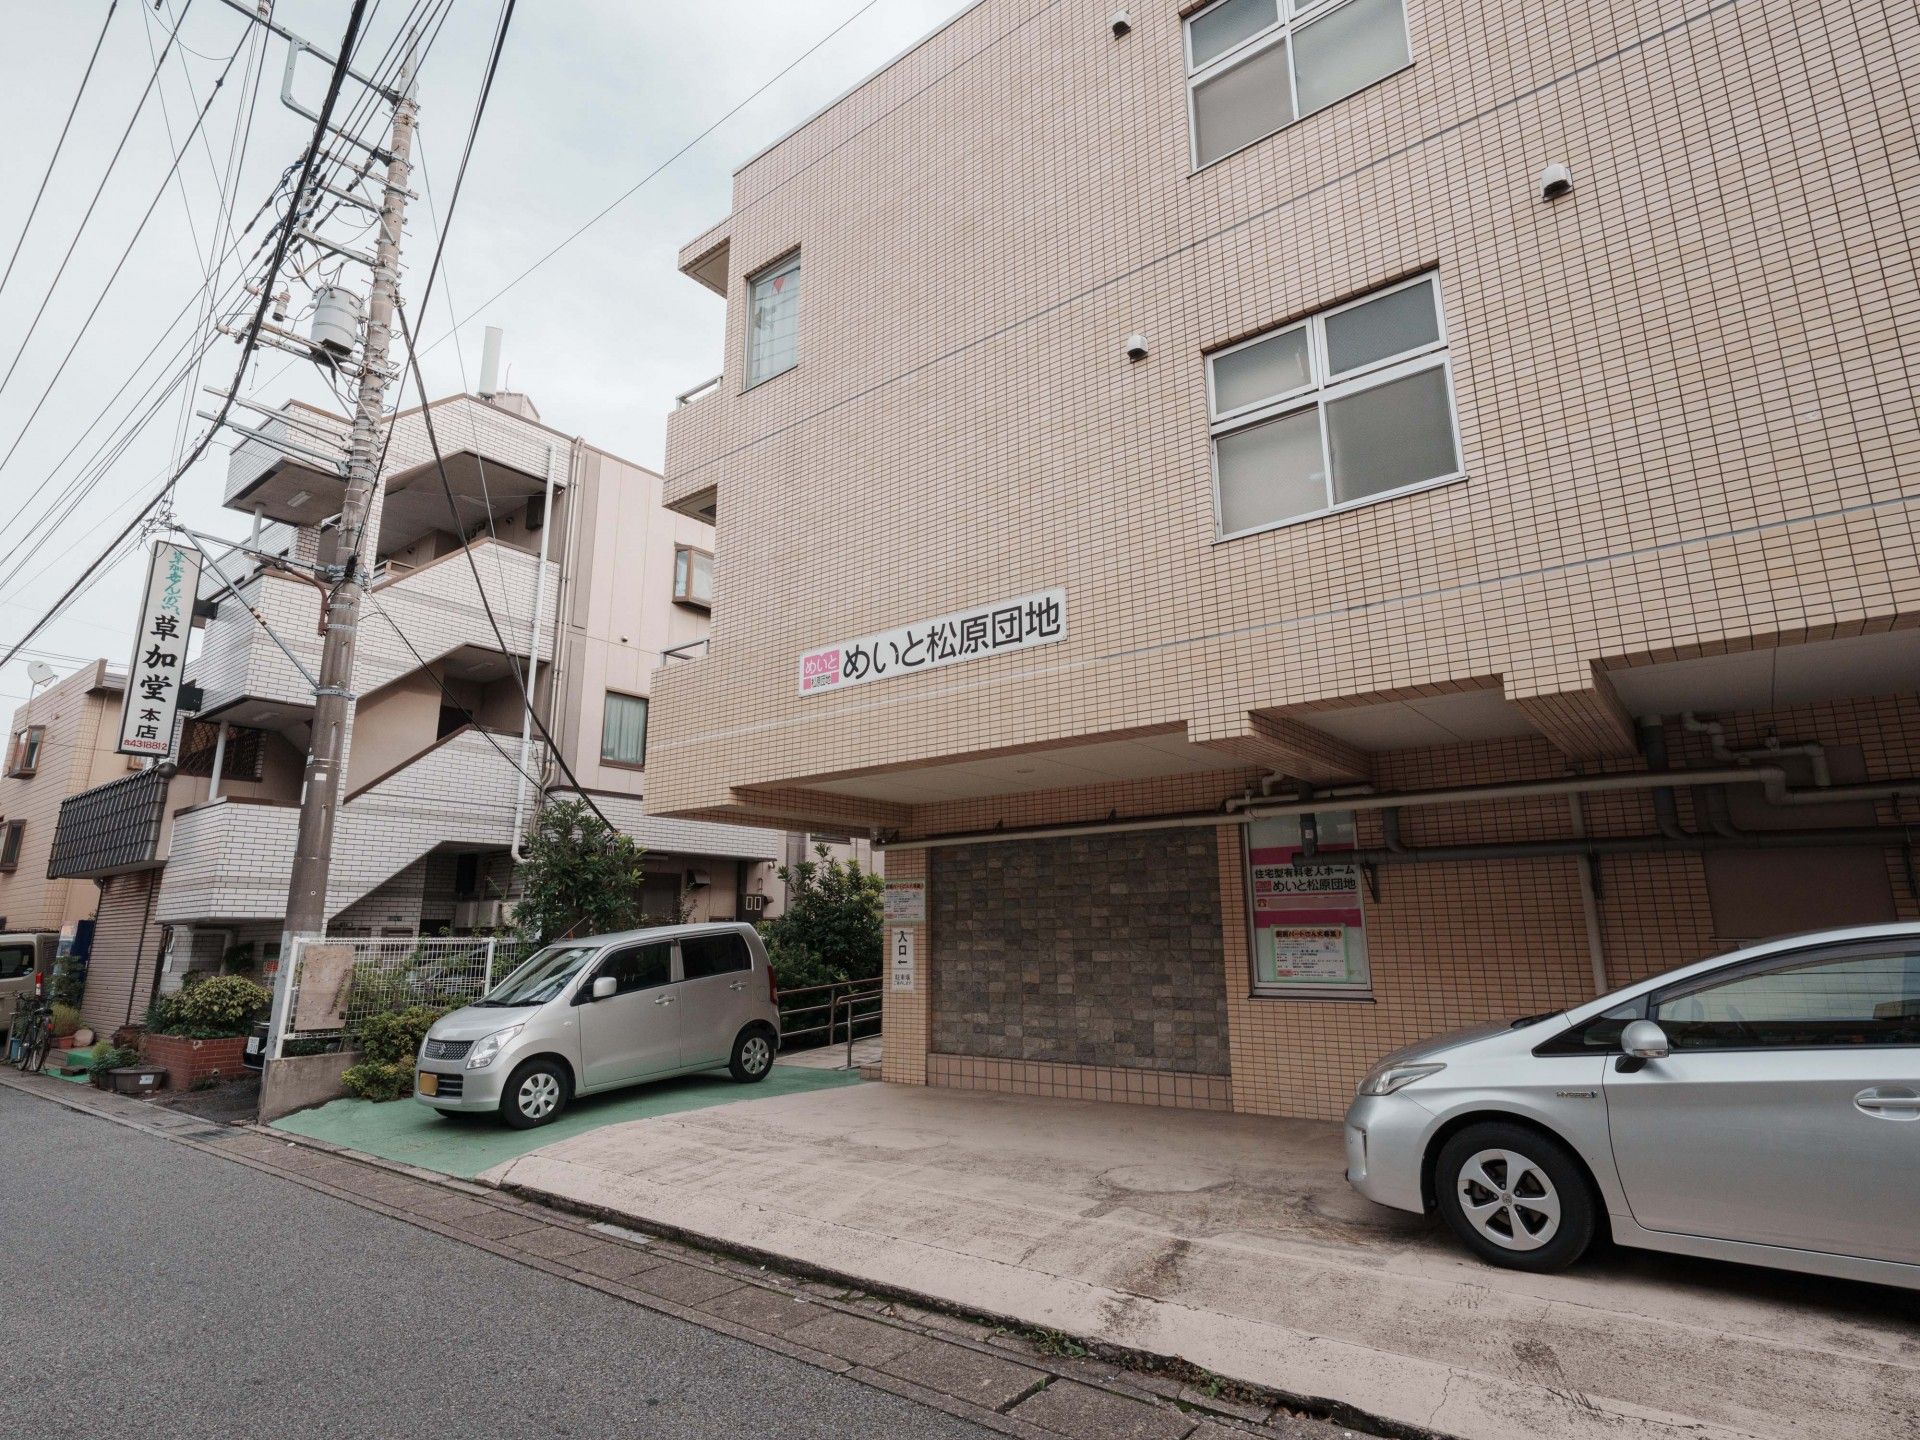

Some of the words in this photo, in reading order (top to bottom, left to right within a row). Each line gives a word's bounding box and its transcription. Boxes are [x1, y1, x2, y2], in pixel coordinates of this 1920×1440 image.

[843, 597, 1061, 680] めいと松原団地
[805, 654, 838, 674] めいと
[135, 614, 180, 740] 草加堂本店
[1255, 865, 1355, 879] 住宅型有料老人ホーム
[1273, 878, 1357, 892] めいと松原団地
[898, 930, 907, 956] 入口
